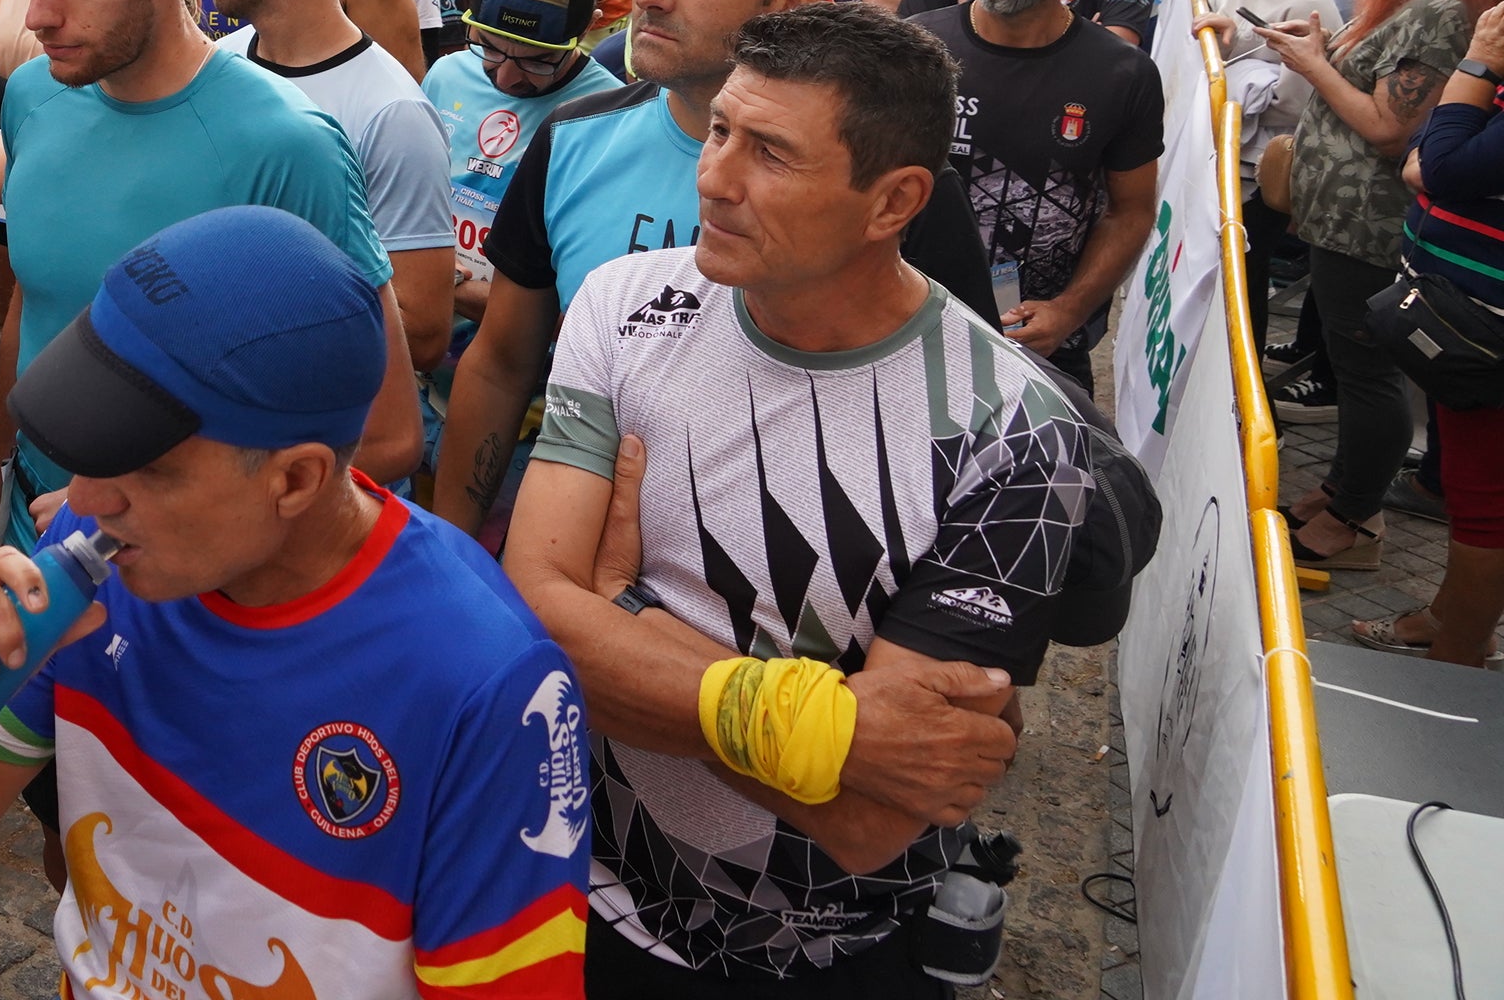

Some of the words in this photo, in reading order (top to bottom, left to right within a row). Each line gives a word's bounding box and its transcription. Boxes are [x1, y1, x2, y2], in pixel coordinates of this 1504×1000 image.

[460, 188, 486, 202] CROSS
[296, 723, 354, 762] DEPORTIVO
[357, 728, 385, 760] HIJOS
[294, 765, 308, 800] CLUB
[381, 759, 398, 784] DEL
[310, 808, 365, 838] GUILLENA
[374, 786, 400, 828] VIENTO
